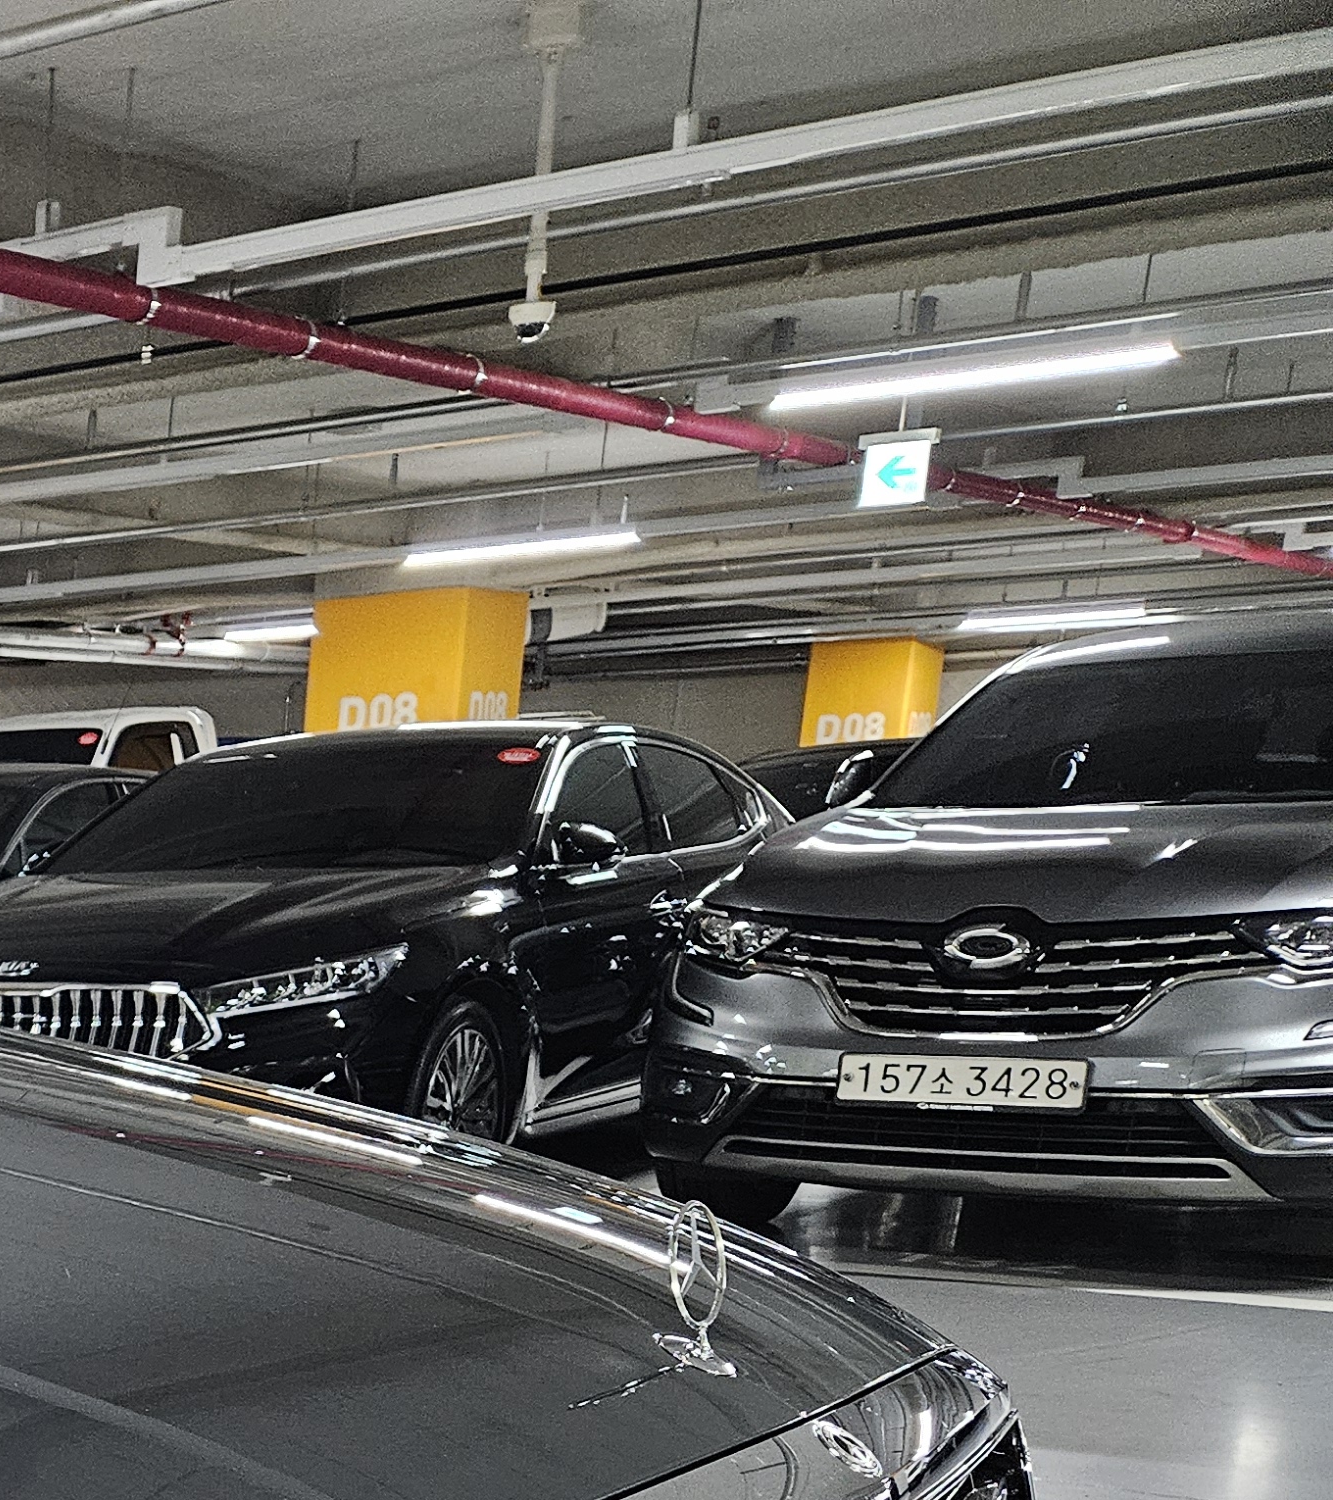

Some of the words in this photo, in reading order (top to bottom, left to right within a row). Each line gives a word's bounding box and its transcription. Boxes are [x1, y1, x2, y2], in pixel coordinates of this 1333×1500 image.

[338, 691, 419, 732] D08
[816, 712, 886, 744] D08
[858, 1062, 954, 1095] 157소
[966, 1066, 1069, 1099] 3428
